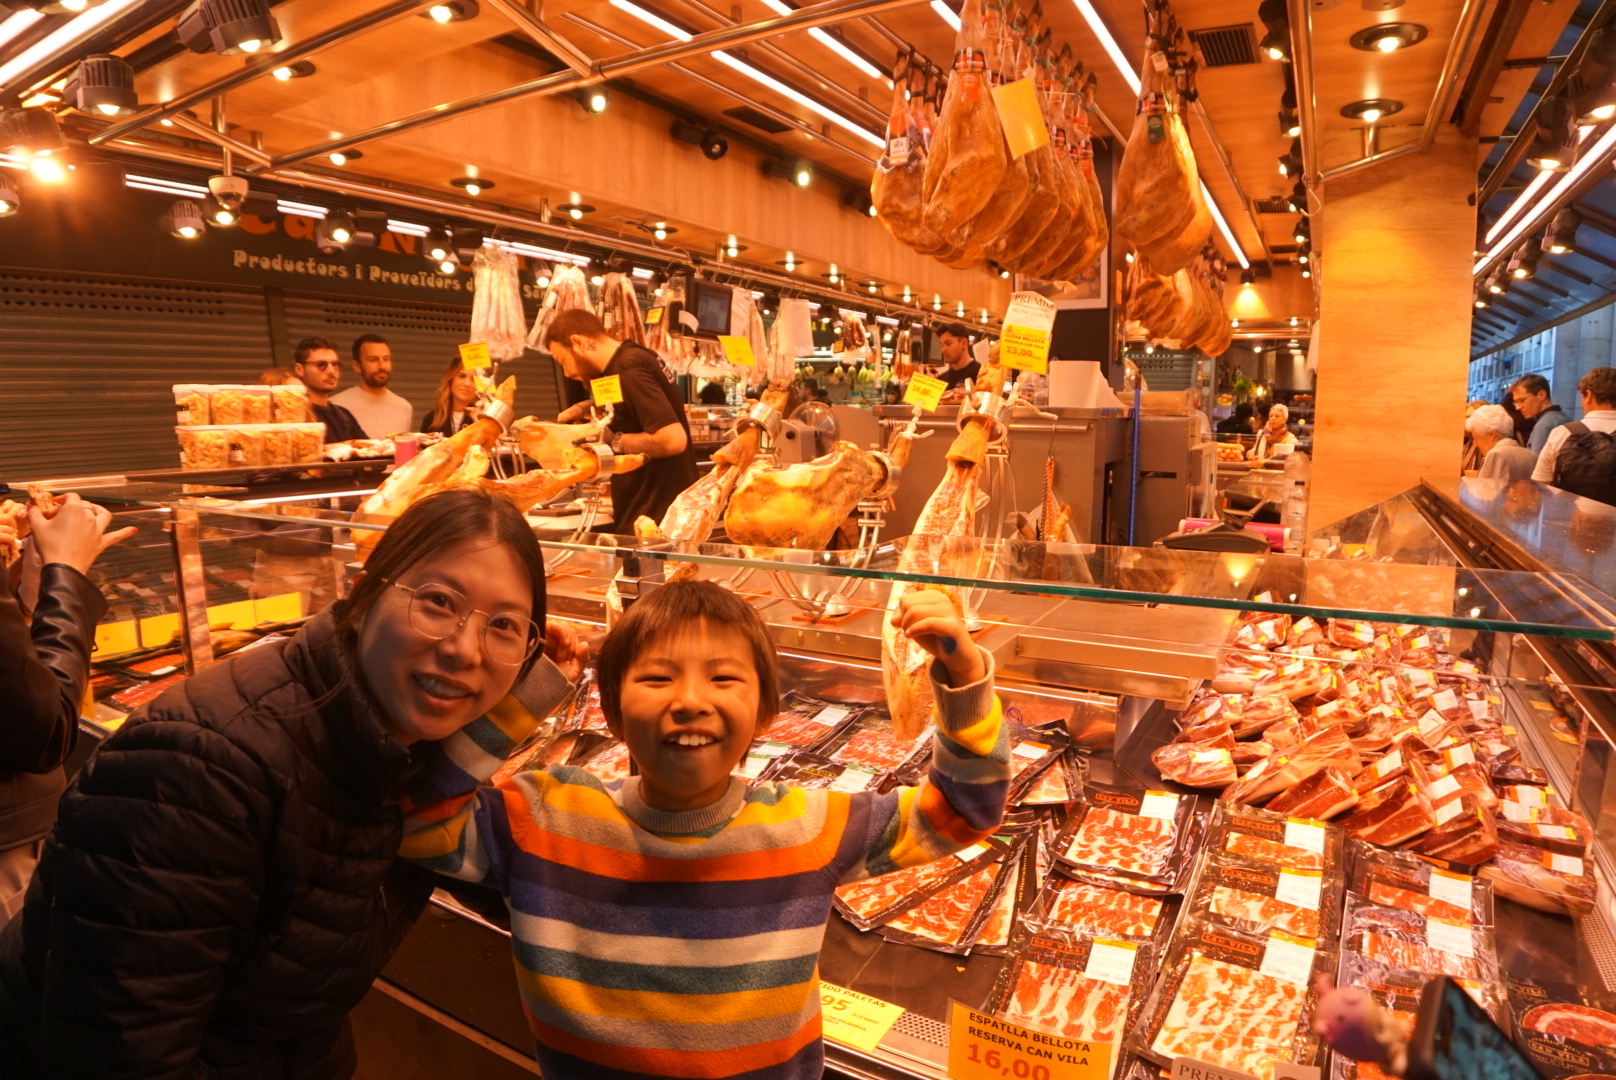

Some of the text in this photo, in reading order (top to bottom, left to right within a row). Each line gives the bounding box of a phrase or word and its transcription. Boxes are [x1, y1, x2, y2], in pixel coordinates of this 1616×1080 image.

[232, 249, 349, 279] Productors
[355, 263, 363, 280] i
[368, 265, 461, 292] Proveïdors
[1014, 293, 1055, 310] PREMIO
[1005, 333, 1045, 344] CUIXA BELLOTA
[1006, 345, 1033, 358] 23,00
[1034, 938, 1081, 954] CAN VILA
[1205, 934, 1255, 953] CAN VILA
[821, 994, 851, 1011] 95
[843, 990, 887, 1009] PALETAS
[969, 1012, 1091, 1052] ESPATLLA BELLOTA
[968, 1026, 1089, 1066] RESERVA CAN VILA
[1530, 1042, 1553, 1054] CAN
[1556, 1050, 1585, 1064] VILA
[967, 1043, 1051, 1080] 16,00
